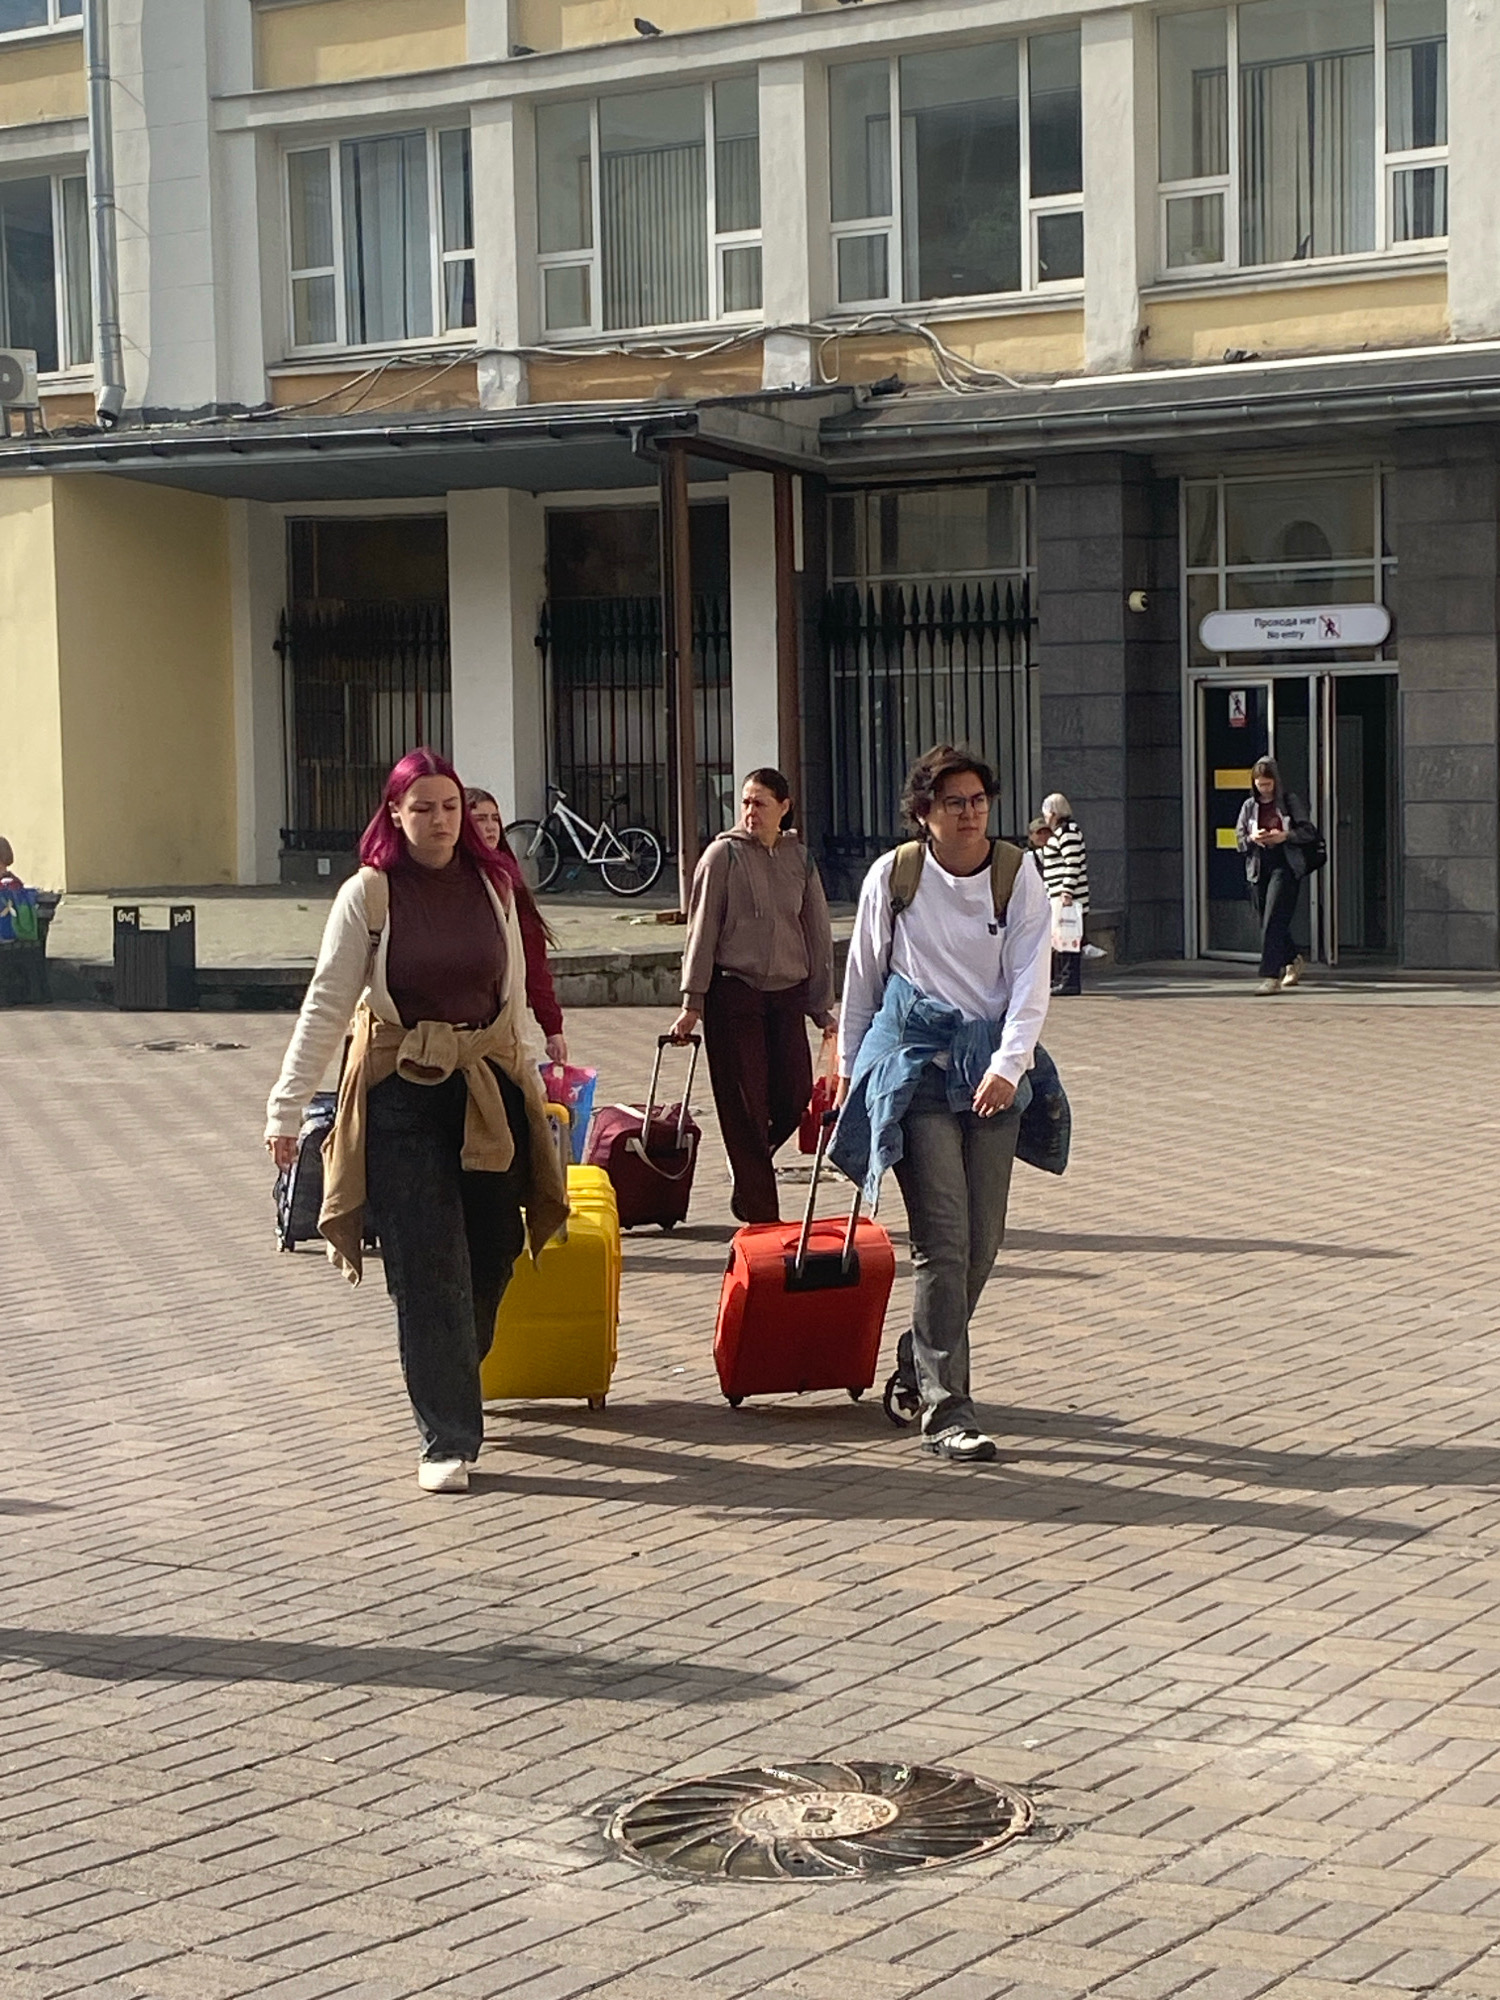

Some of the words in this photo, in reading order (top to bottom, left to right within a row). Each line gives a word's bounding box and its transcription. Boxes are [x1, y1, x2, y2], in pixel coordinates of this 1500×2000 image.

[1254, 617, 1298, 629] Прохода
[1300, 617, 1317, 625] нет
[1267, 631, 1280, 639] No
[1281, 630, 1306, 640] entry
